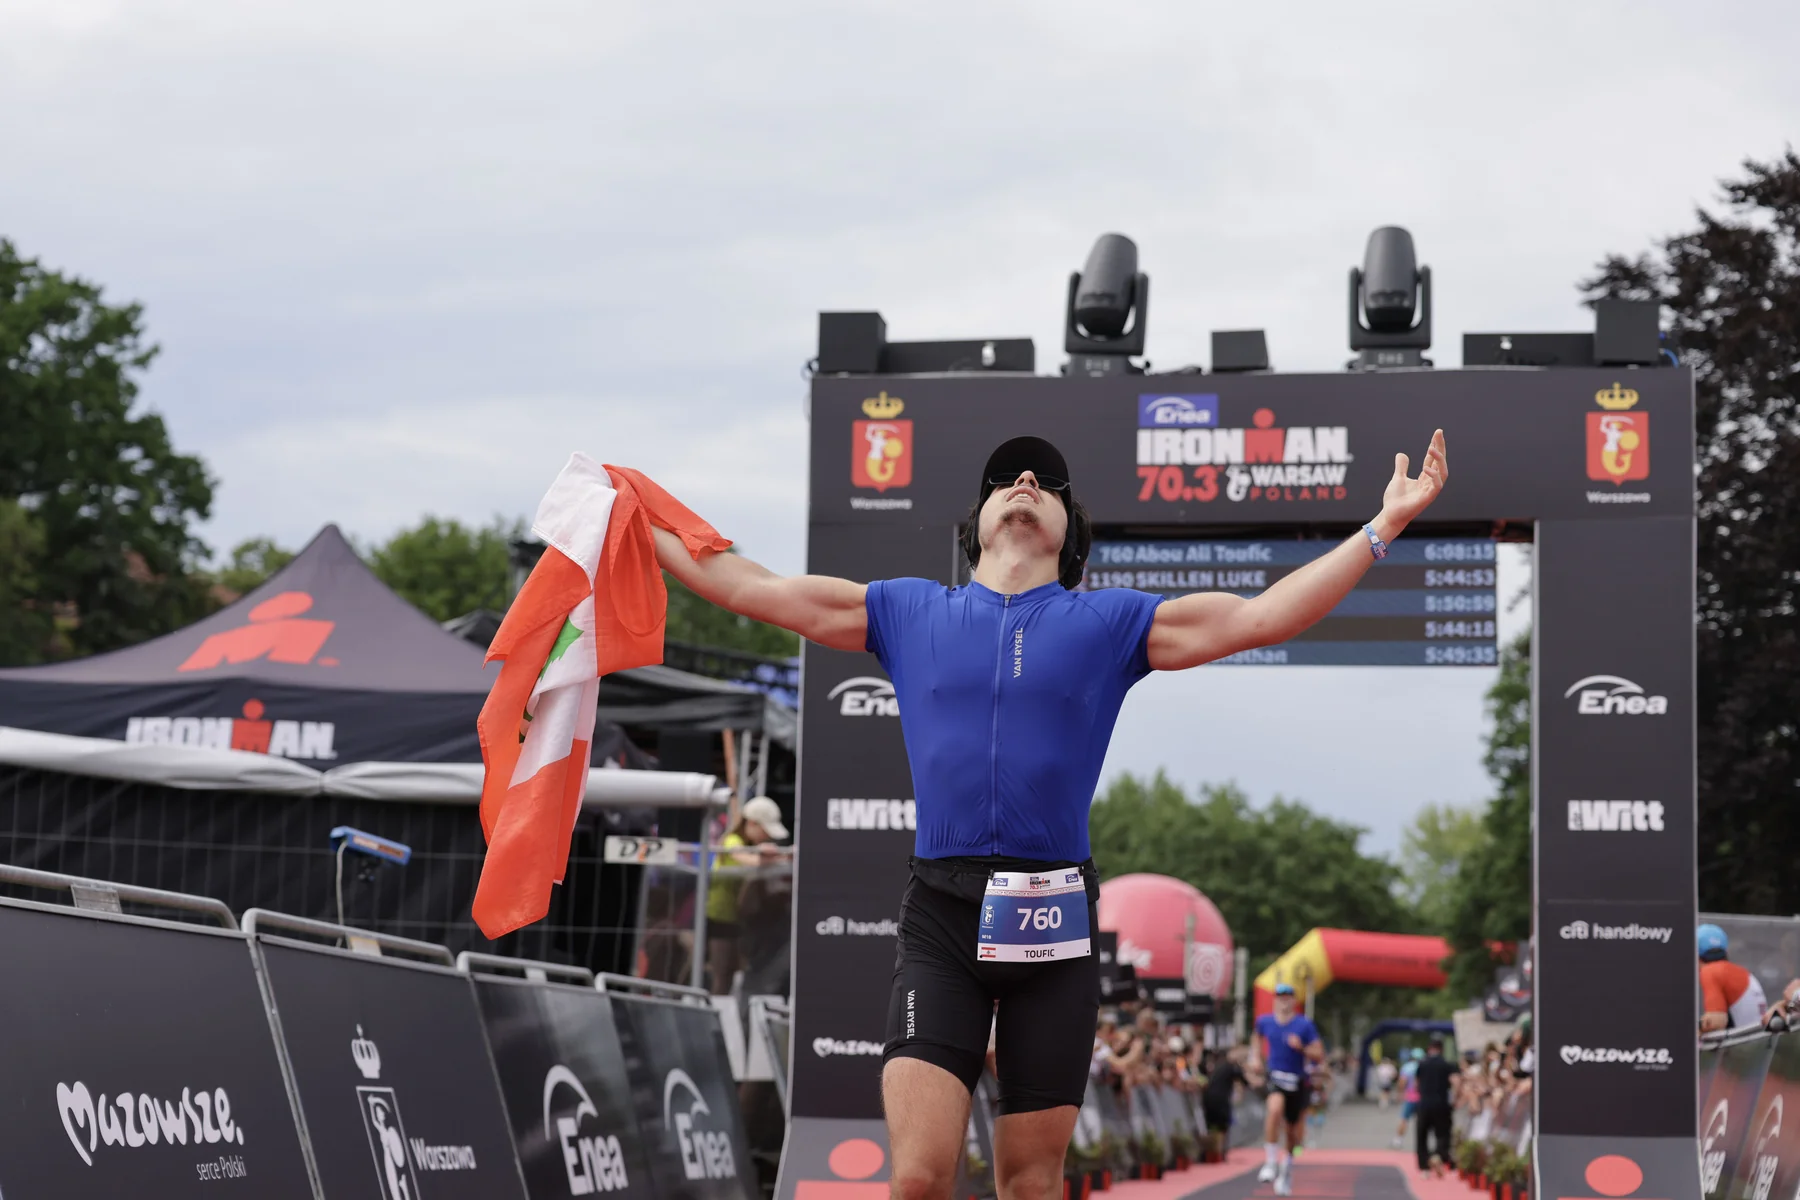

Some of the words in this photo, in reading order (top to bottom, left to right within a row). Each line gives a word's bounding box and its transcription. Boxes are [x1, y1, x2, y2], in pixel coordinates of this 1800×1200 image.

[1155, 405, 1212, 424] Enea
[1137, 408, 1352, 465] IRONMAN
[1137, 465, 1219, 501] 70.3
[1250, 465, 1347, 486] WARSAW
[1250, 487, 1347, 499] POLAND
[1136, 571, 1213, 588] SKILLEN
[1217, 570, 1267, 588] LUKE
[1014, 627, 1024, 656] RYSEL
[1013, 657, 1022, 678] VAN
[1578, 690, 1668, 715] Enea
[125, 698, 338, 759] IRONMAN
[1017, 906, 1062, 931] 760
[1560, 920, 1590, 939] citi
[1593, 923, 1673, 943] handlowy
[1024, 948, 1055, 959] TOUFIC
[907, 989, 916, 1010] VAN
[906, 1011, 915, 1040] RYSEL
[409, 1137, 477, 1170] Warszawa
[556, 1116, 629, 1196] Enea
[674, 1112, 736, 1181] Enea
[196, 1161, 220, 1181] serce
[221, 1155, 247, 1178] Polski
